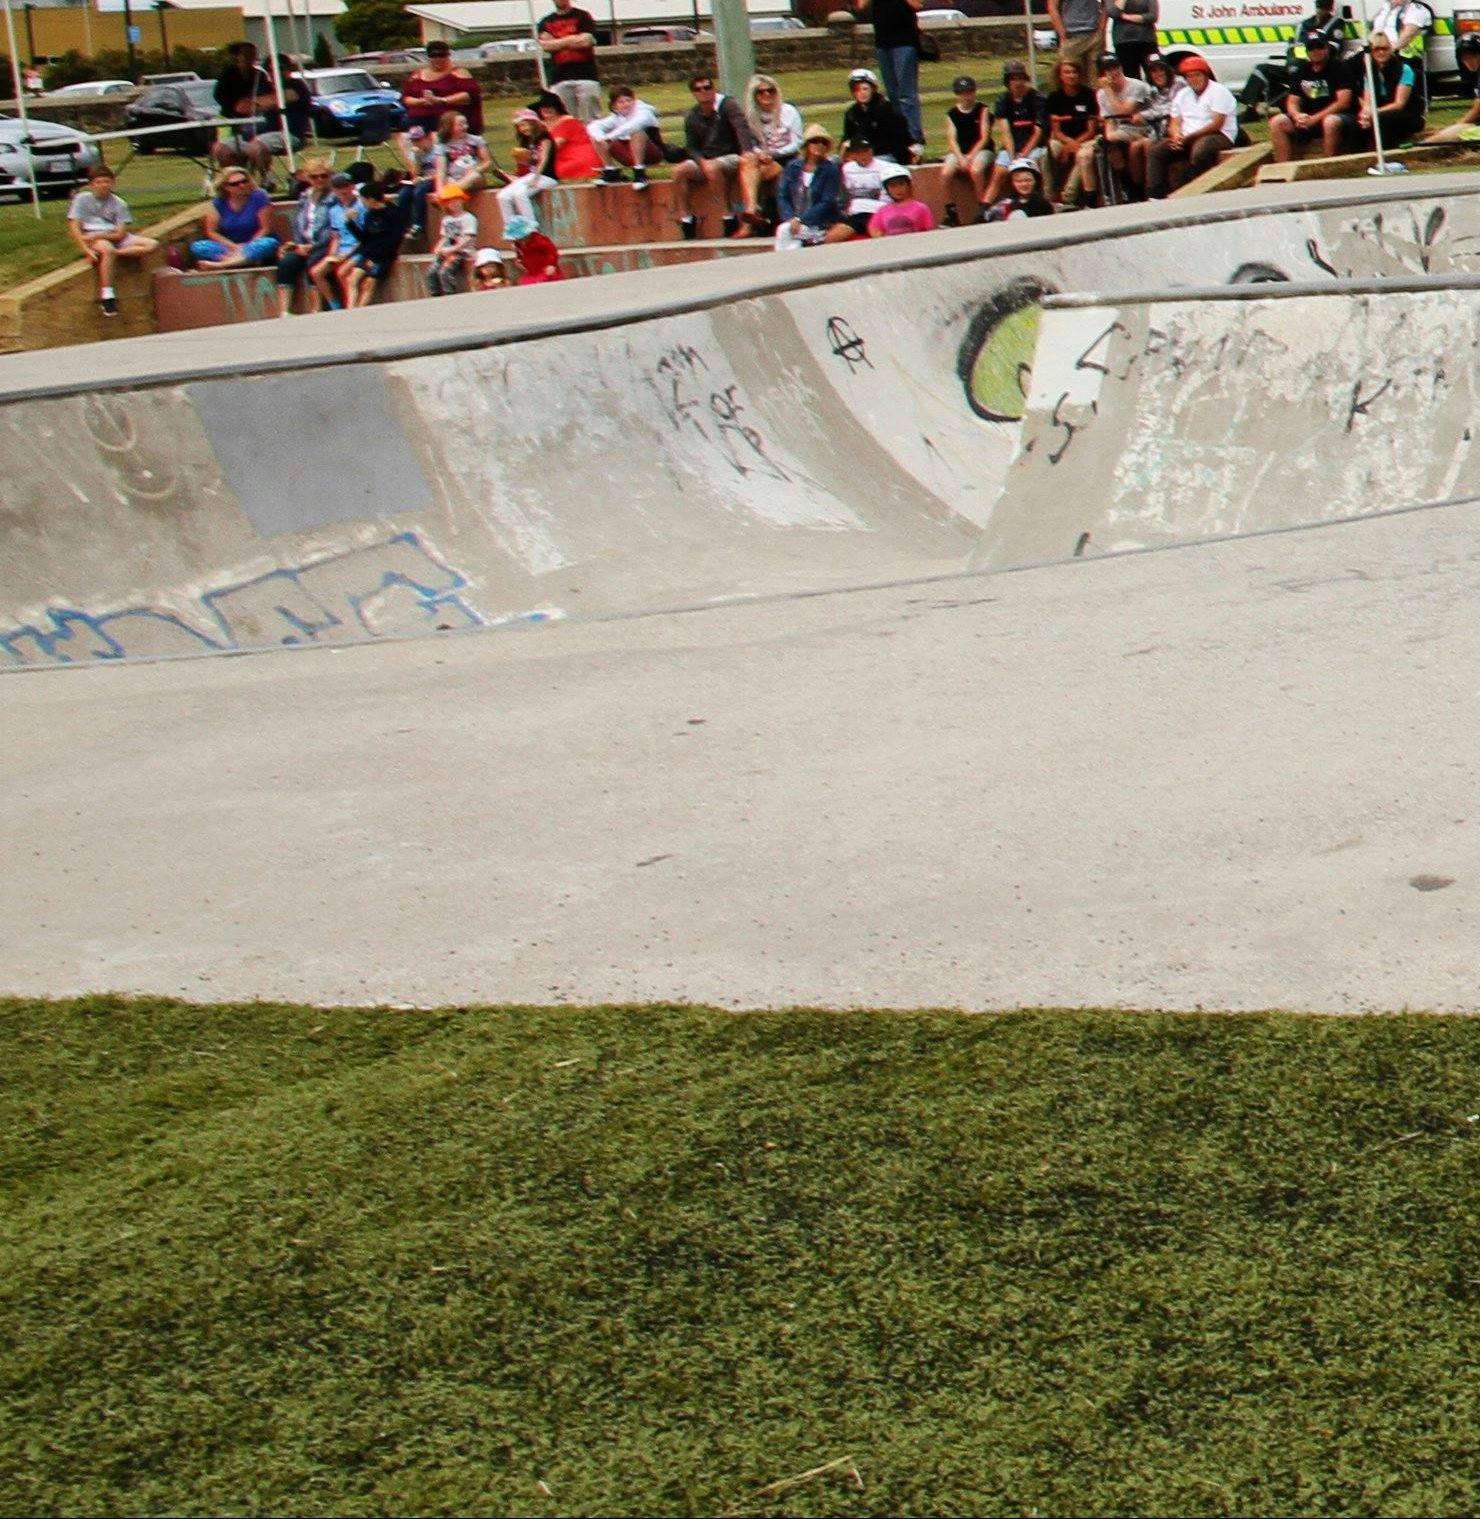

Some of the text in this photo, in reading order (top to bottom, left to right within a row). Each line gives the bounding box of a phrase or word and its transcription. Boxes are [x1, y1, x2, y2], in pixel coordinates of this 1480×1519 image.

[1191, 3, 1303, 19] St John Ambulance
